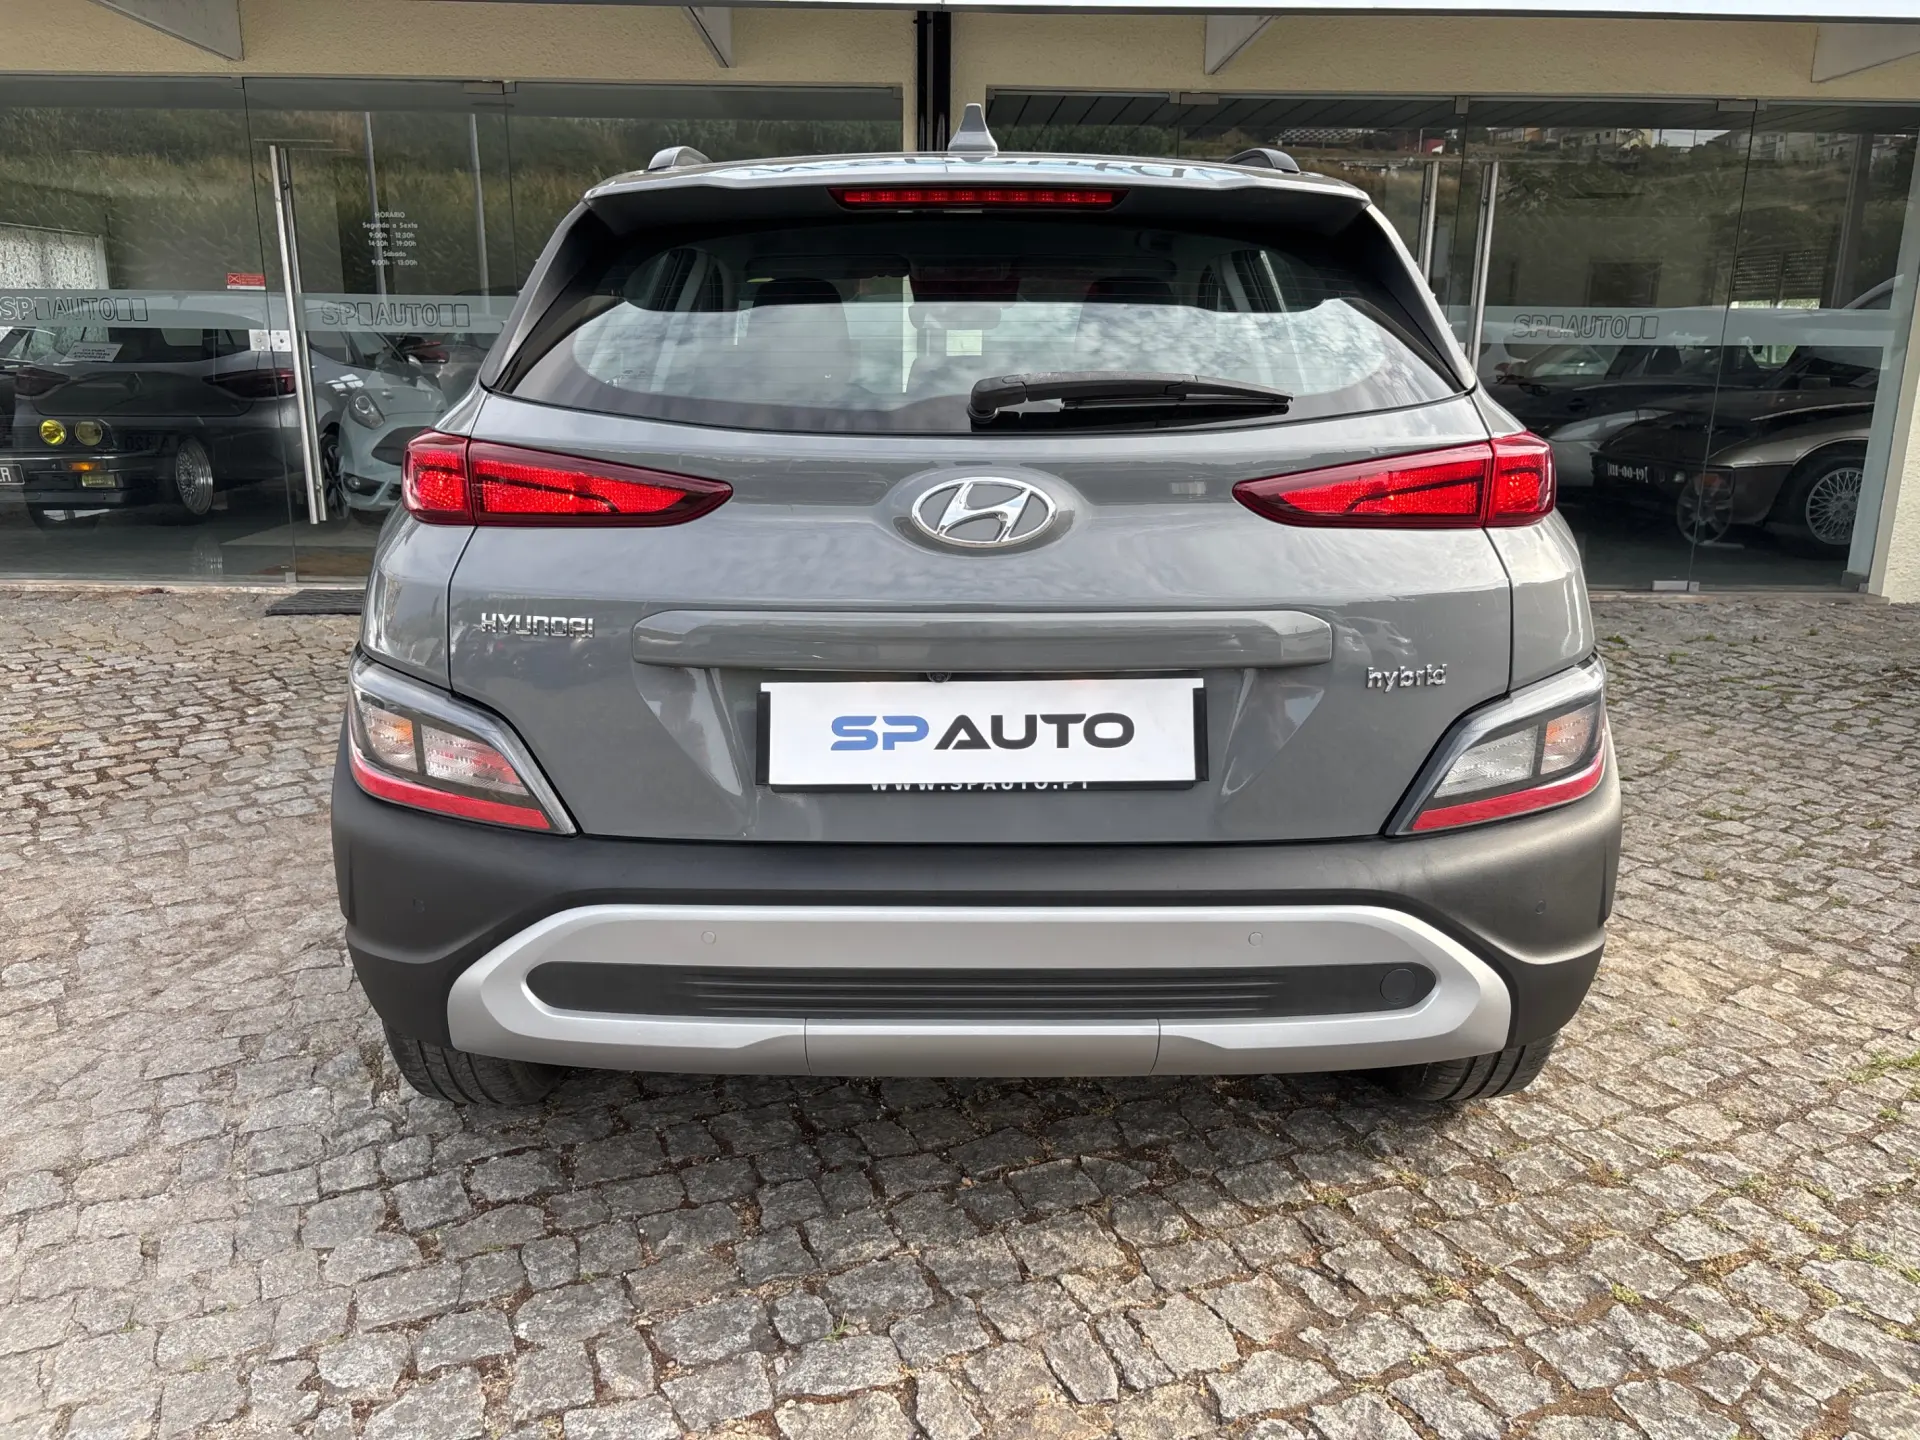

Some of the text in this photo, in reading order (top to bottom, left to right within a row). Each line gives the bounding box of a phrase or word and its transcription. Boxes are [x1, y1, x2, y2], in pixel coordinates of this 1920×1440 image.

[362, 222, 390, 230] Segunda
[480, 612, 595, 638] HYUNDAI
[1366, 663, 1448, 693] hybrid
